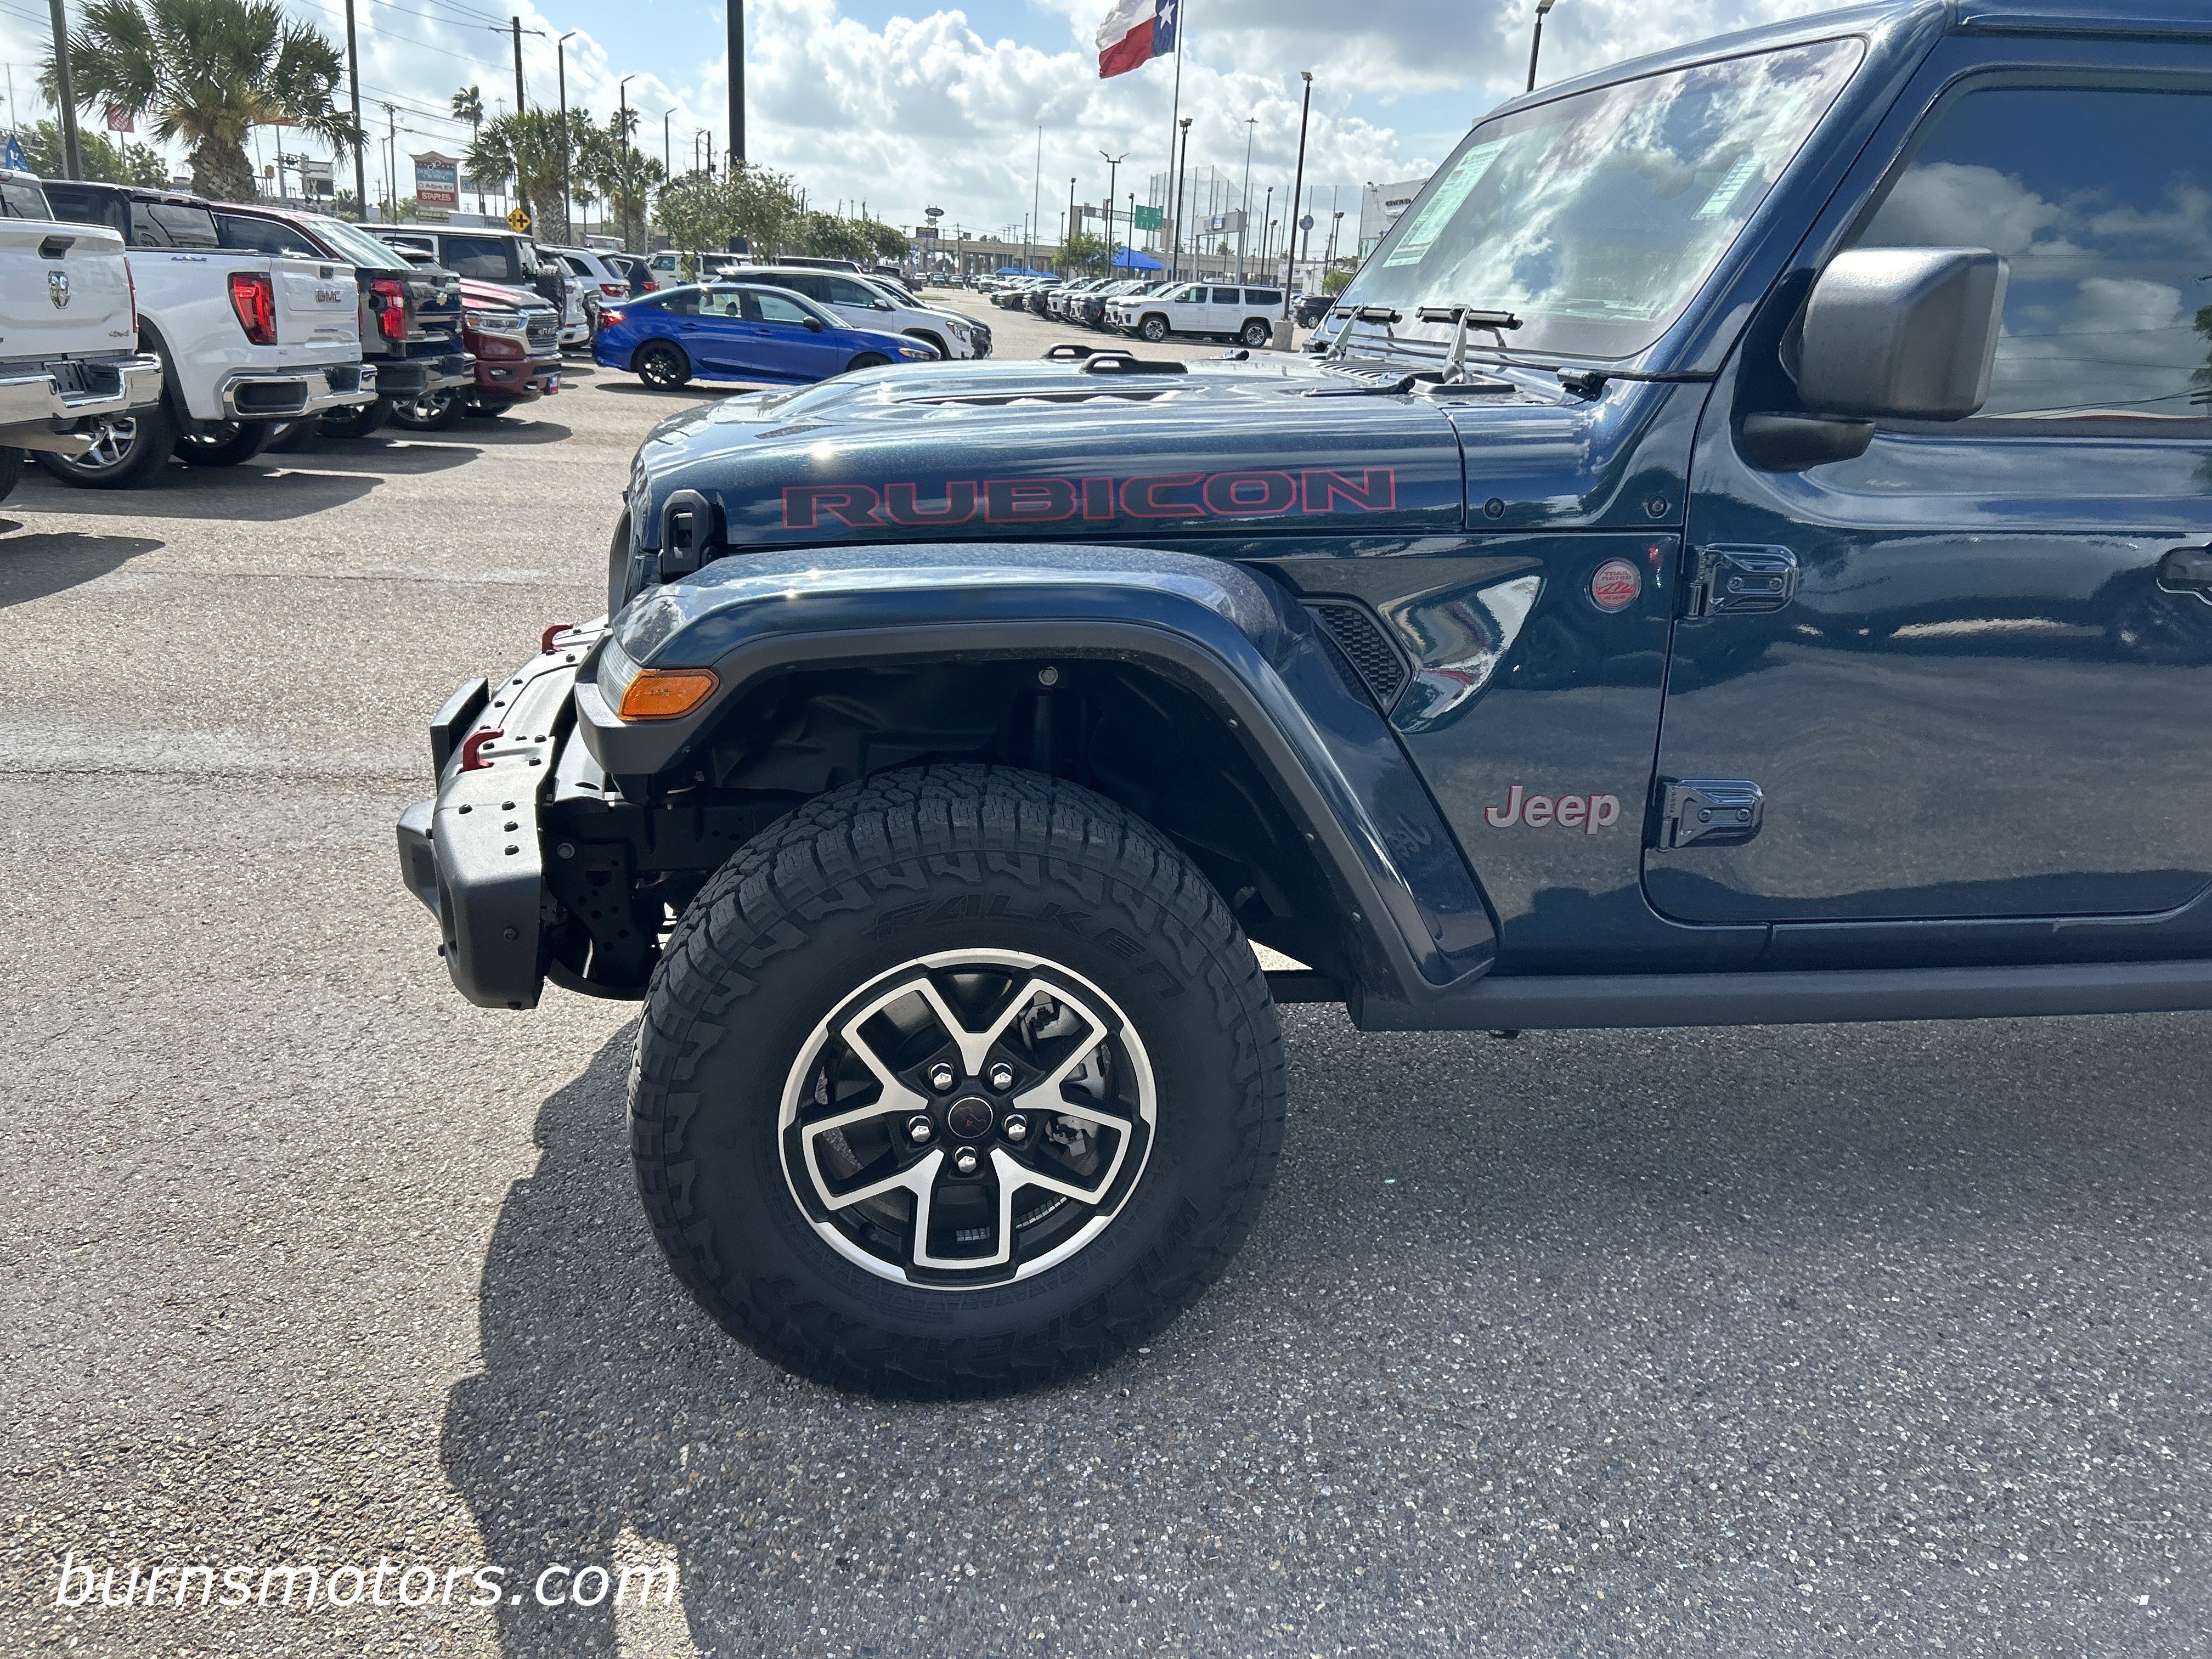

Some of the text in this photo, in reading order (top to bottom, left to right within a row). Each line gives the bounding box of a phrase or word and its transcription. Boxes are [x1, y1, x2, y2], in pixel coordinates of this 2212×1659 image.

[421, 192, 452, 201] STAPLES
[425, 183, 454, 191] ASHLEY
[315, 290, 341, 303] GMC
[782, 467, 1396, 529] RUBICON
[1485, 785, 1620, 834] Jeep
[864, 893, 1187, 1001] FALKEN
